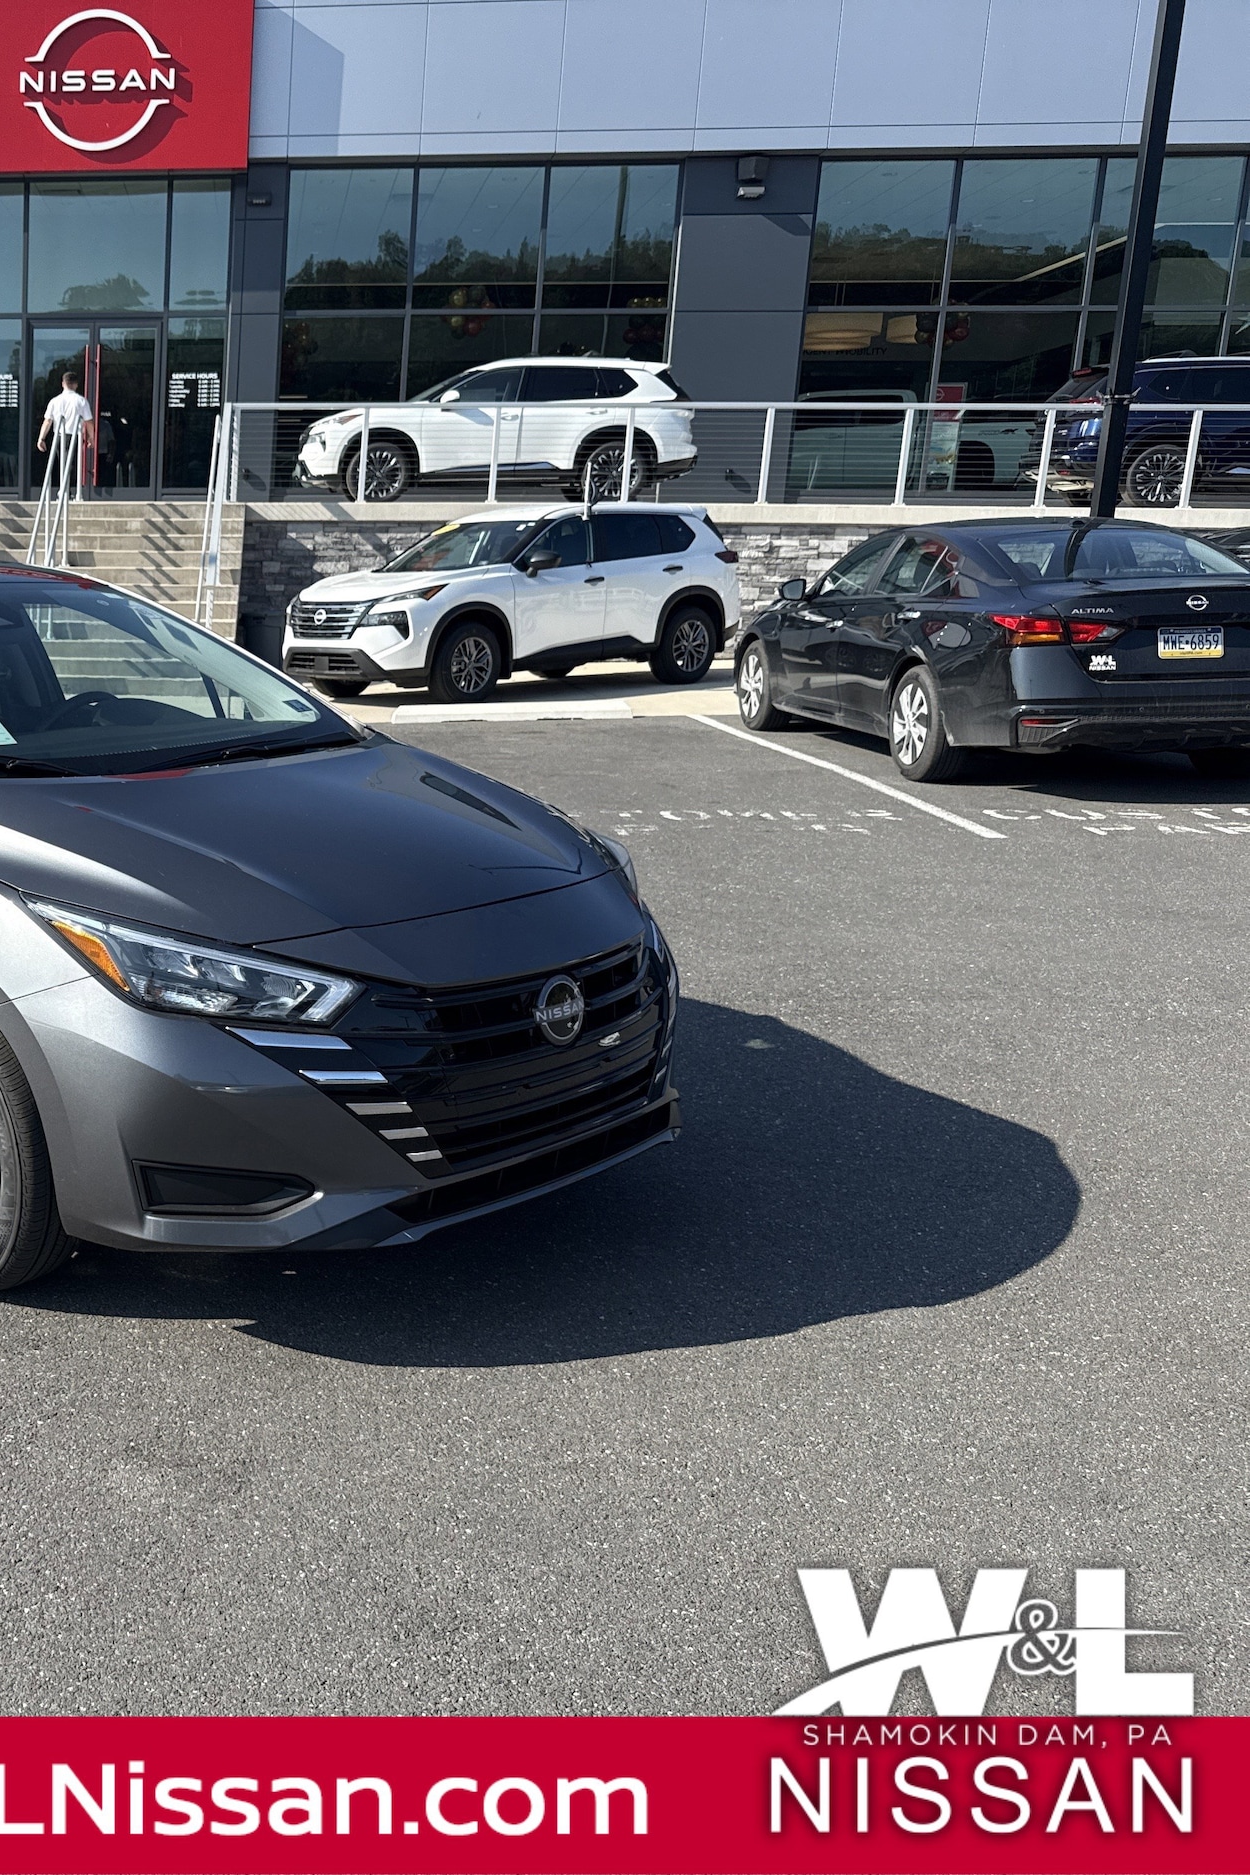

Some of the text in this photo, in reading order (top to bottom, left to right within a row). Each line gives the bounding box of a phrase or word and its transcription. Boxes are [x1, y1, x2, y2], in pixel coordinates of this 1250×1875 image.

[19, 67, 176, 94] NISSAN
[1071, 607, 1114, 615] ALTIMA
[1190, 634, 1219, 650] 6859
[535, 1001, 584, 1022] NISSAN
